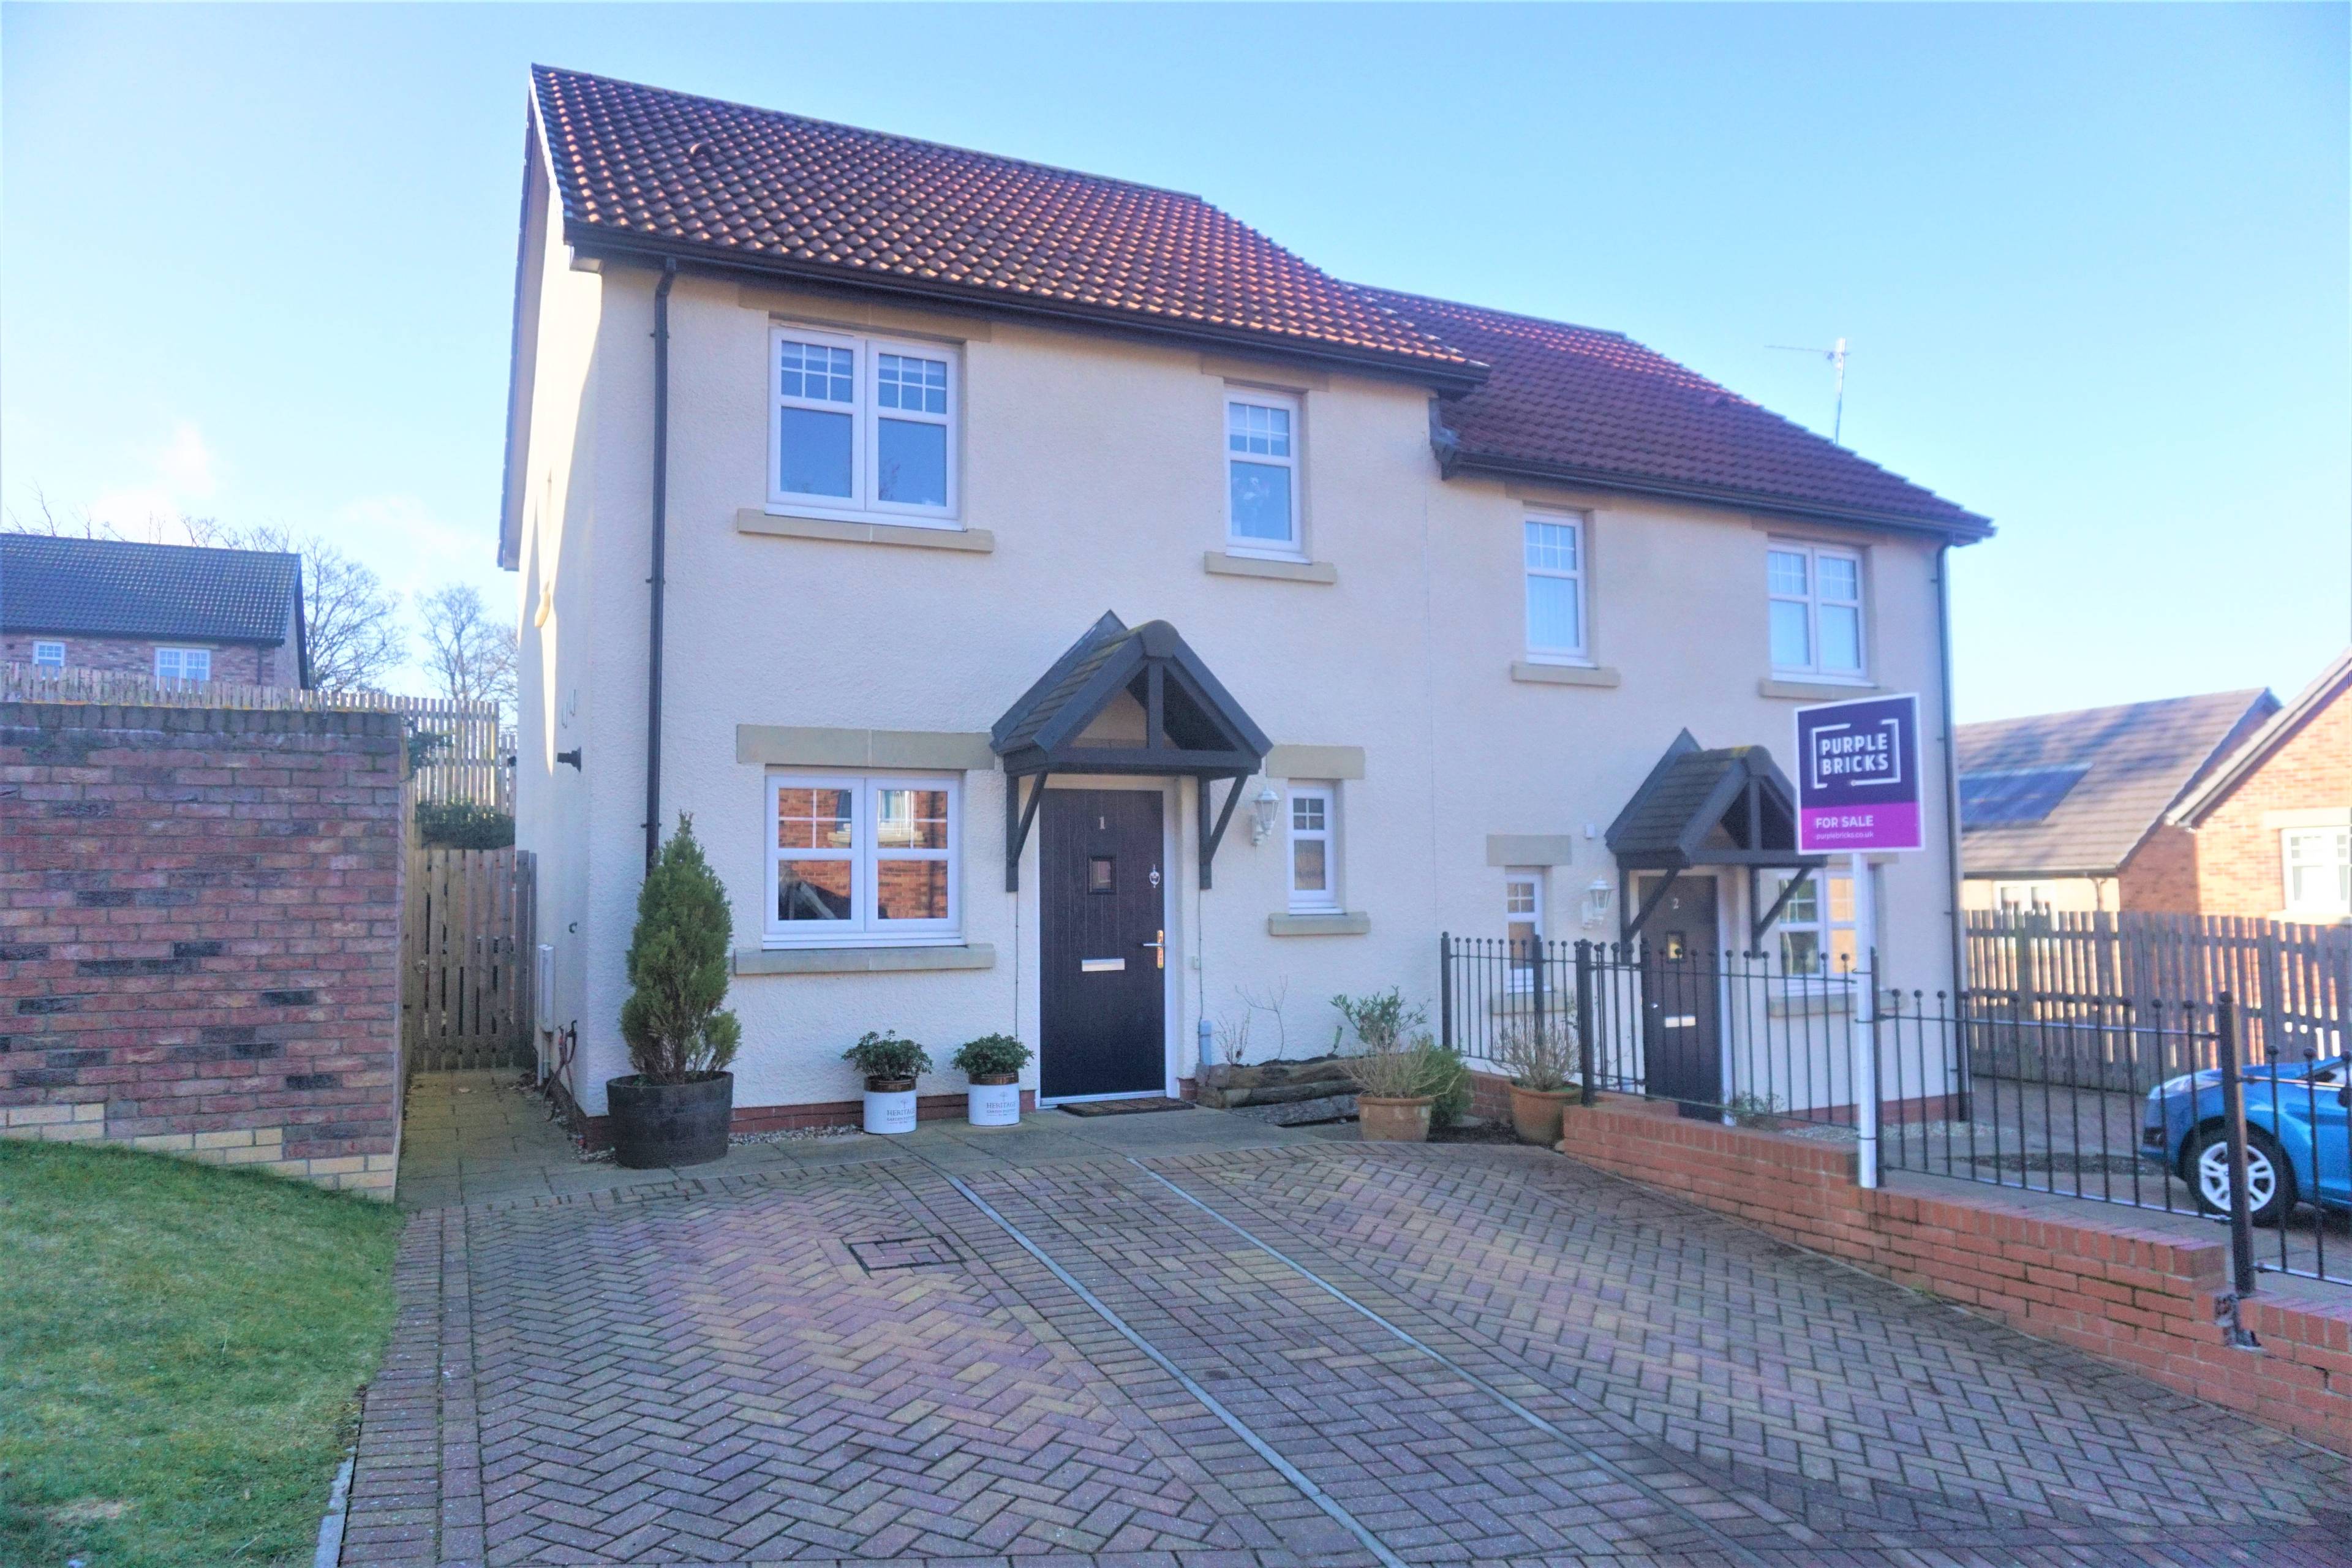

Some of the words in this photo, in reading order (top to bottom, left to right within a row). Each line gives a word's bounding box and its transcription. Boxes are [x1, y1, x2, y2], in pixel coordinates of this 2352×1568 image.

[1821, 733, 1888, 756] PURPLE
[1822, 753, 1888, 775] BRICKS
[1099, 816, 1106, 829] 1
[1816, 816, 1838, 829] FOR
[1842, 815, 1874, 827] SALE
[1816, 831, 1874, 840] purplebricks.co.uk
[1673, 898, 1679, 909] 2
